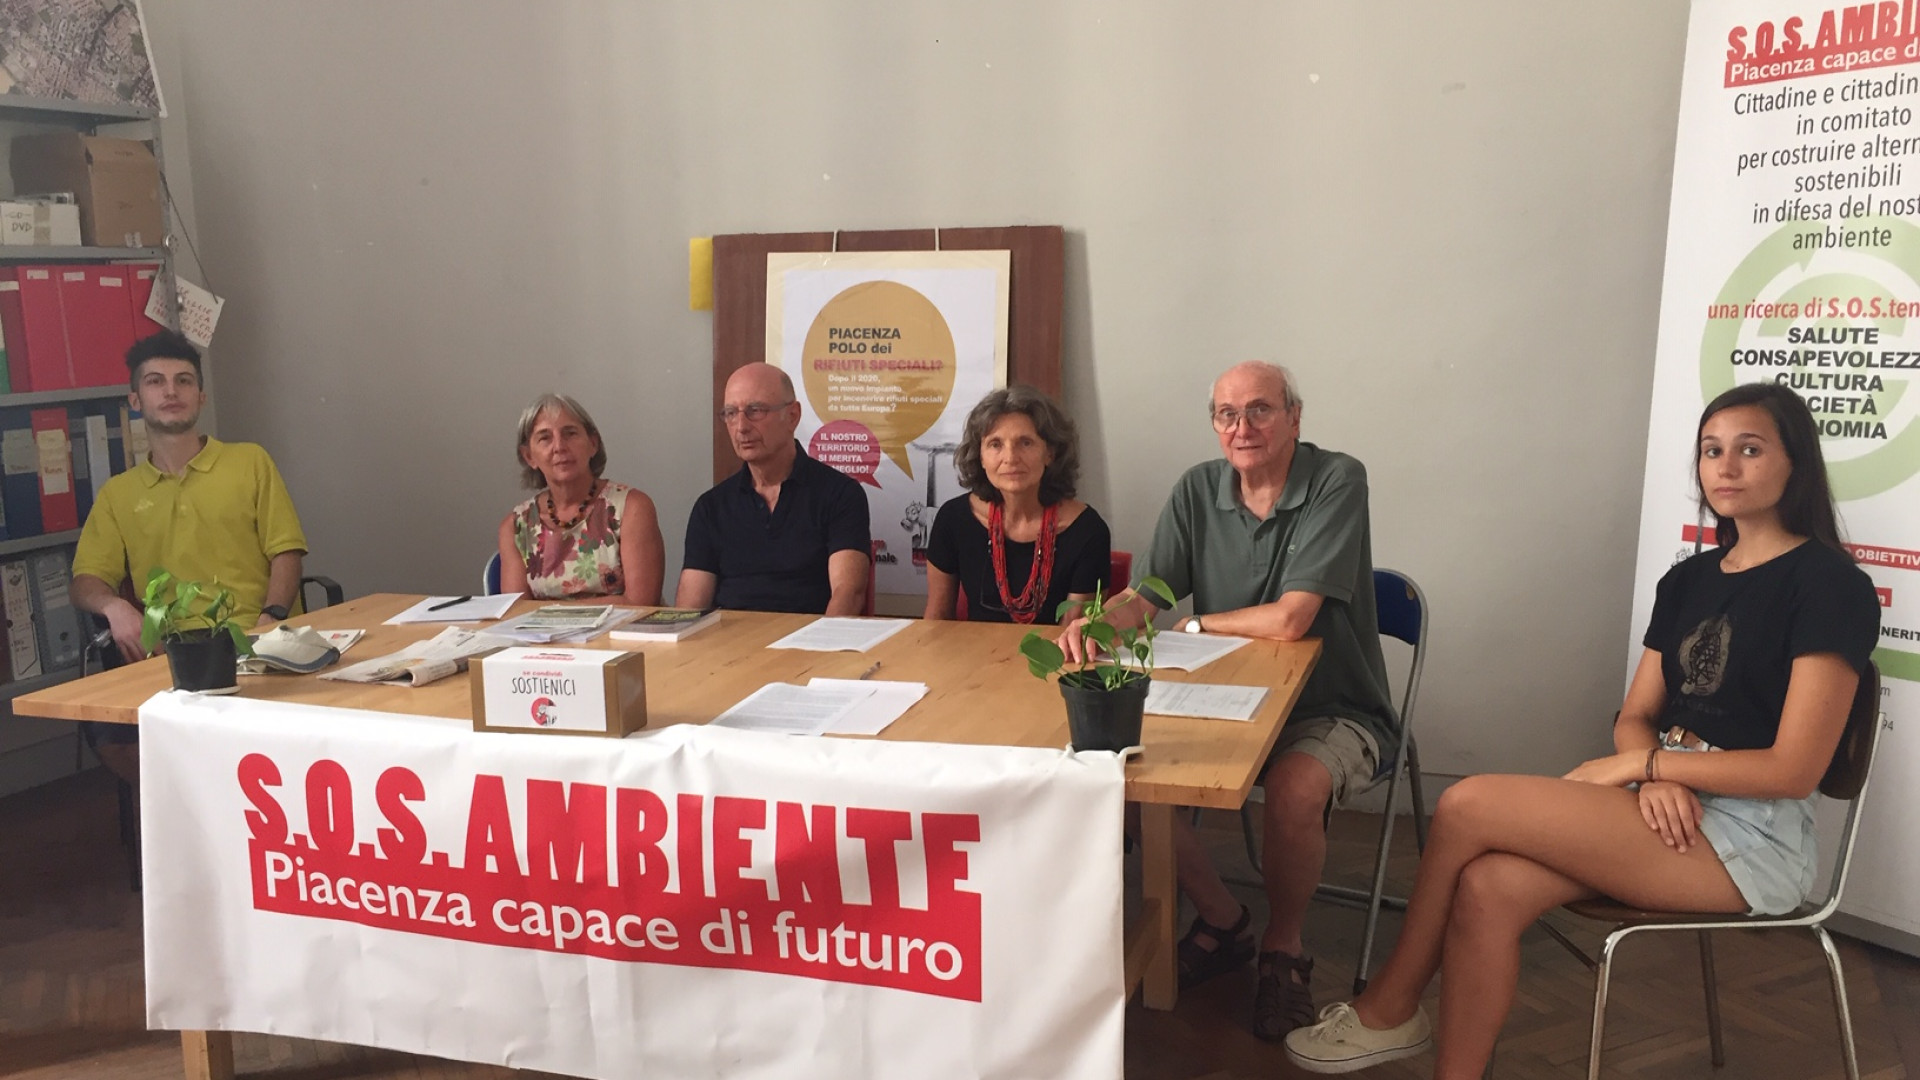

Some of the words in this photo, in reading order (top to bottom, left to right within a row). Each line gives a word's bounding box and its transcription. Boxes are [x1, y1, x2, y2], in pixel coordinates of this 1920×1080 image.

[1727, 16, 1809, 61] S.O.S.
[1730, 57, 1815, 83] Piacenza
[1822, 45, 1896, 71] capace
[1904, 36, 1920, 58] d
[1734, 86, 1817, 115] Cittadine
[1823, 87, 1835, 105] e
[1796, 114, 1814, 136] in
[1821, 105, 1912, 133] comitato
[1737, 149, 1768, 177] per
[1772, 139, 1856, 167] costruire
[1794, 162, 1902, 193] sostenibili
[1753, 203, 1769, 224] in
[1775, 198, 1832, 222] difesa
[1839, 194, 1872, 218] del
[12, 222, 32, 232] DVD
[1792, 226, 1892, 249] ambiente
[1707, 302, 1739, 319] una
[1744, 299, 1799, 319] ricerca
[1804, 297, 1822, 318] di
[829, 328, 901, 339] PIACENZA
[1788, 327, 1879, 344] SALUTE
[829, 342, 867, 354] POLO
[871, 342, 892, 354] dei
[814, 359, 865, 371] RIFIUTI
[828, 374, 849, 383] Dopo
[1775, 372, 1884, 392] CULTURA
[828, 404, 839, 412] da
[1805, 394, 1878, 415] CIETÀ
[820, 433, 829, 441] IL
[831, 433, 868, 442] NOSTRO
[1815, 420, 1887, 439] NOMIA
[816, 443, 870, 452] TERRITORIO
[818, 454, 827, 462] SI
[829, 454, 863, 463] MERITA
[512, 677, 576, 696] SOSTIENICI
[237, 752, 450, 867] S.O.S.
[464, 773, 981, 911] AMBIENTE
[265, 850, 476, 928] Piacenza
[492, 897, 680, 950] capace
[700, 907, 753, 956] di
[773, 910, 964, 981] futuro
